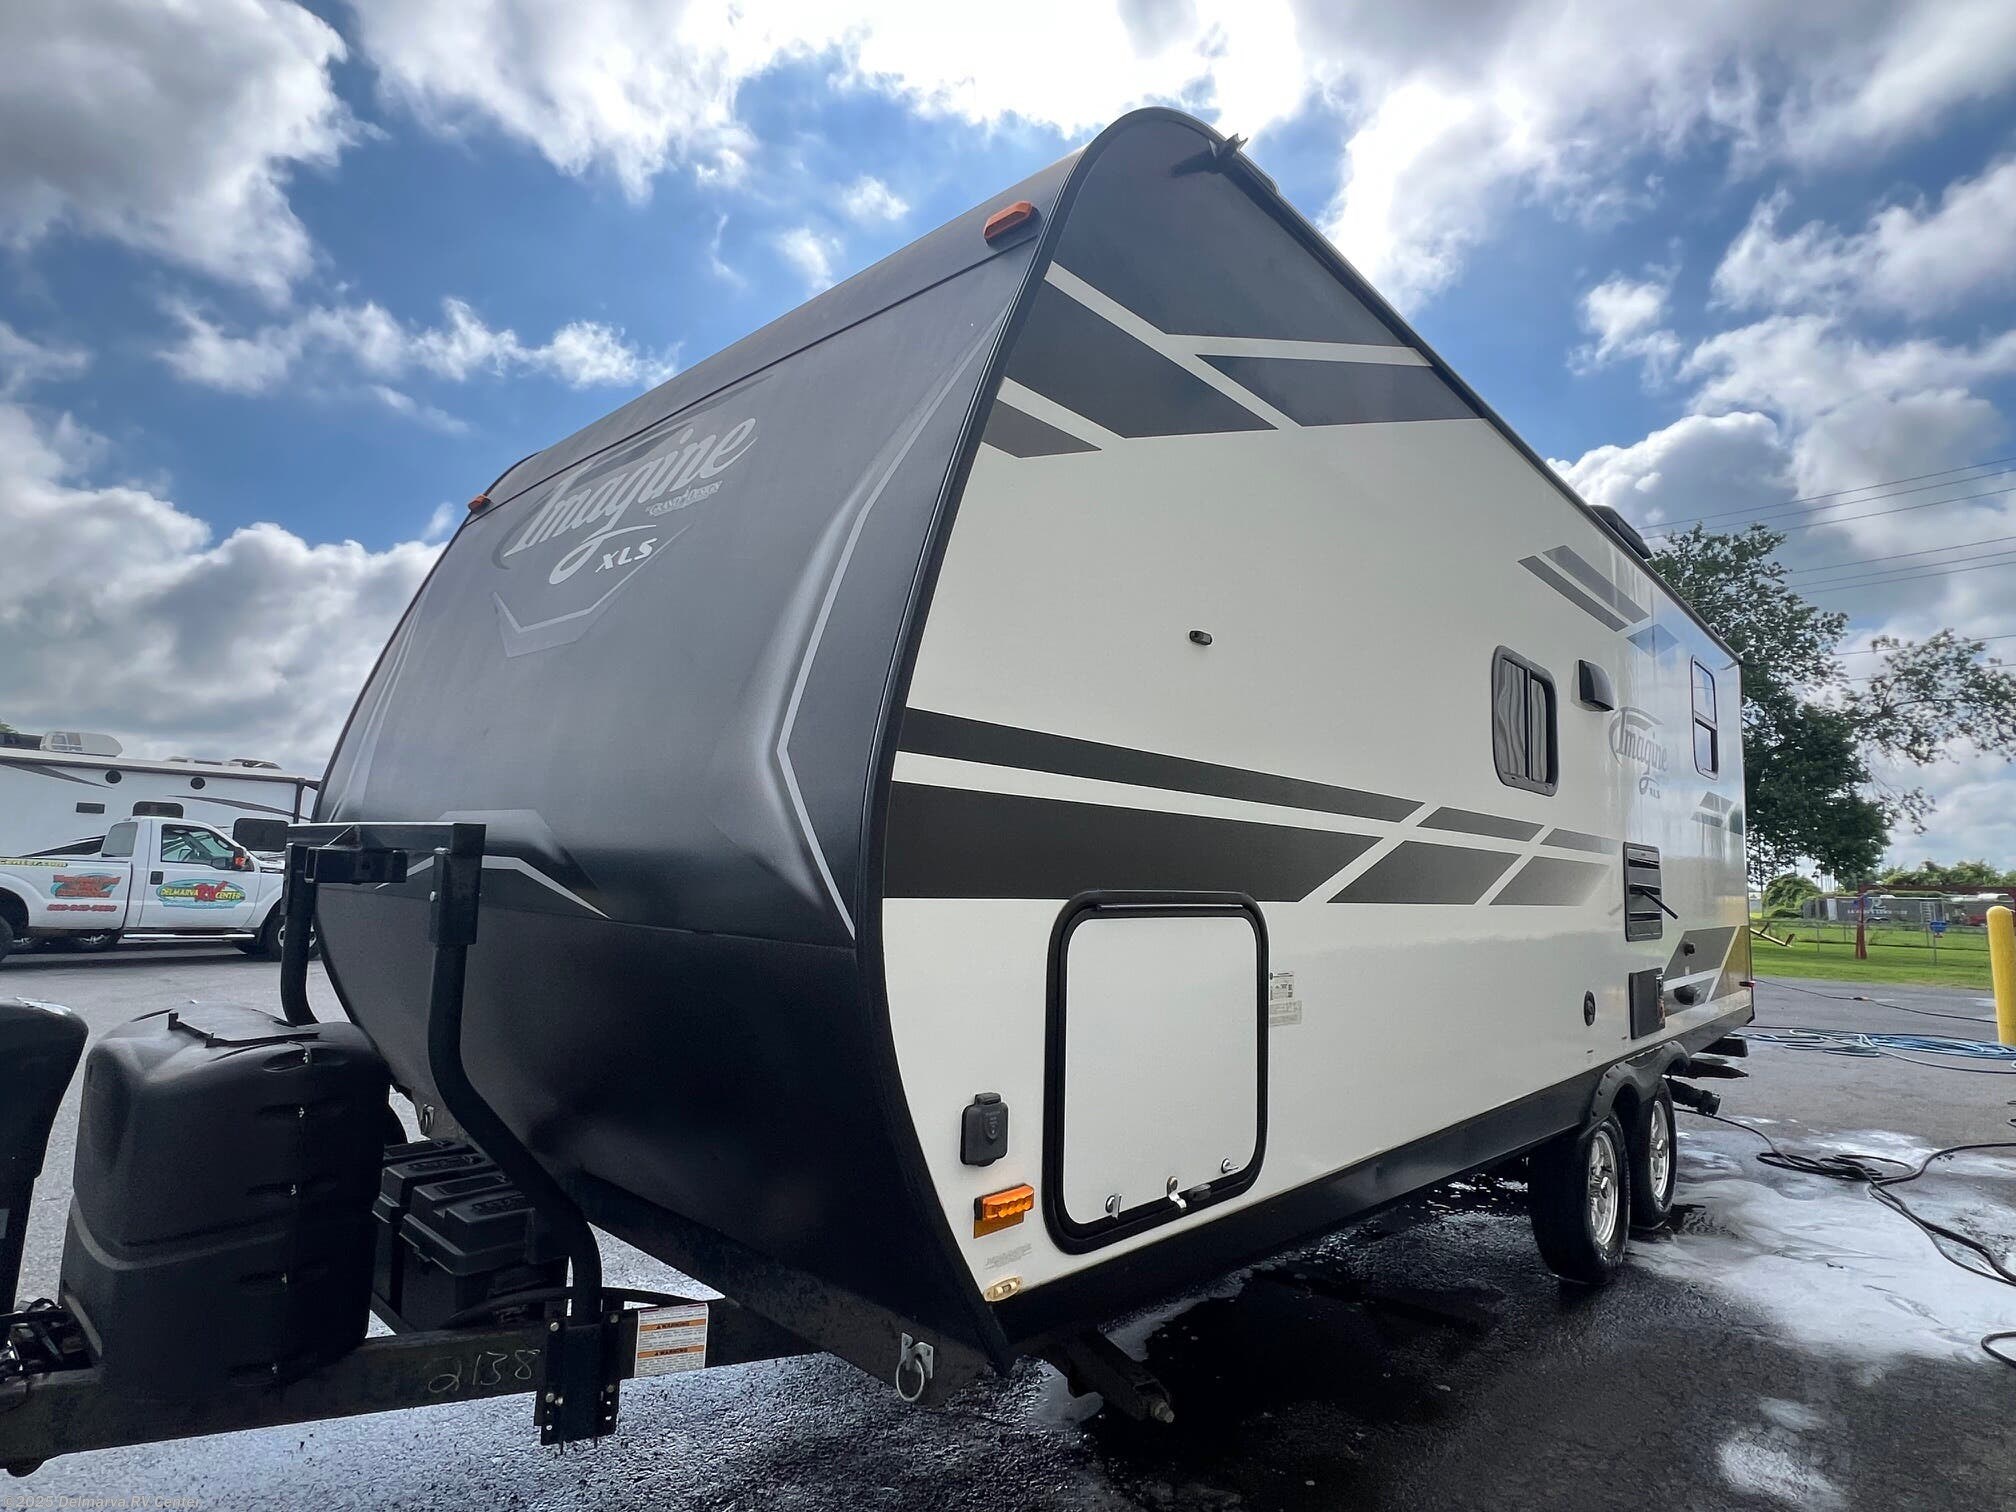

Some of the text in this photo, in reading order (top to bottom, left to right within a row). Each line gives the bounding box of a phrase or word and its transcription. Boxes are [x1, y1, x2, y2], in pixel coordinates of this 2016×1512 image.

[504, 417, 758, 585] Imagine
[595, 537, 658, 573] XLS
[161, 887, 199, 897] DELMARVA
[215, 891, 242, 900] CENTER
